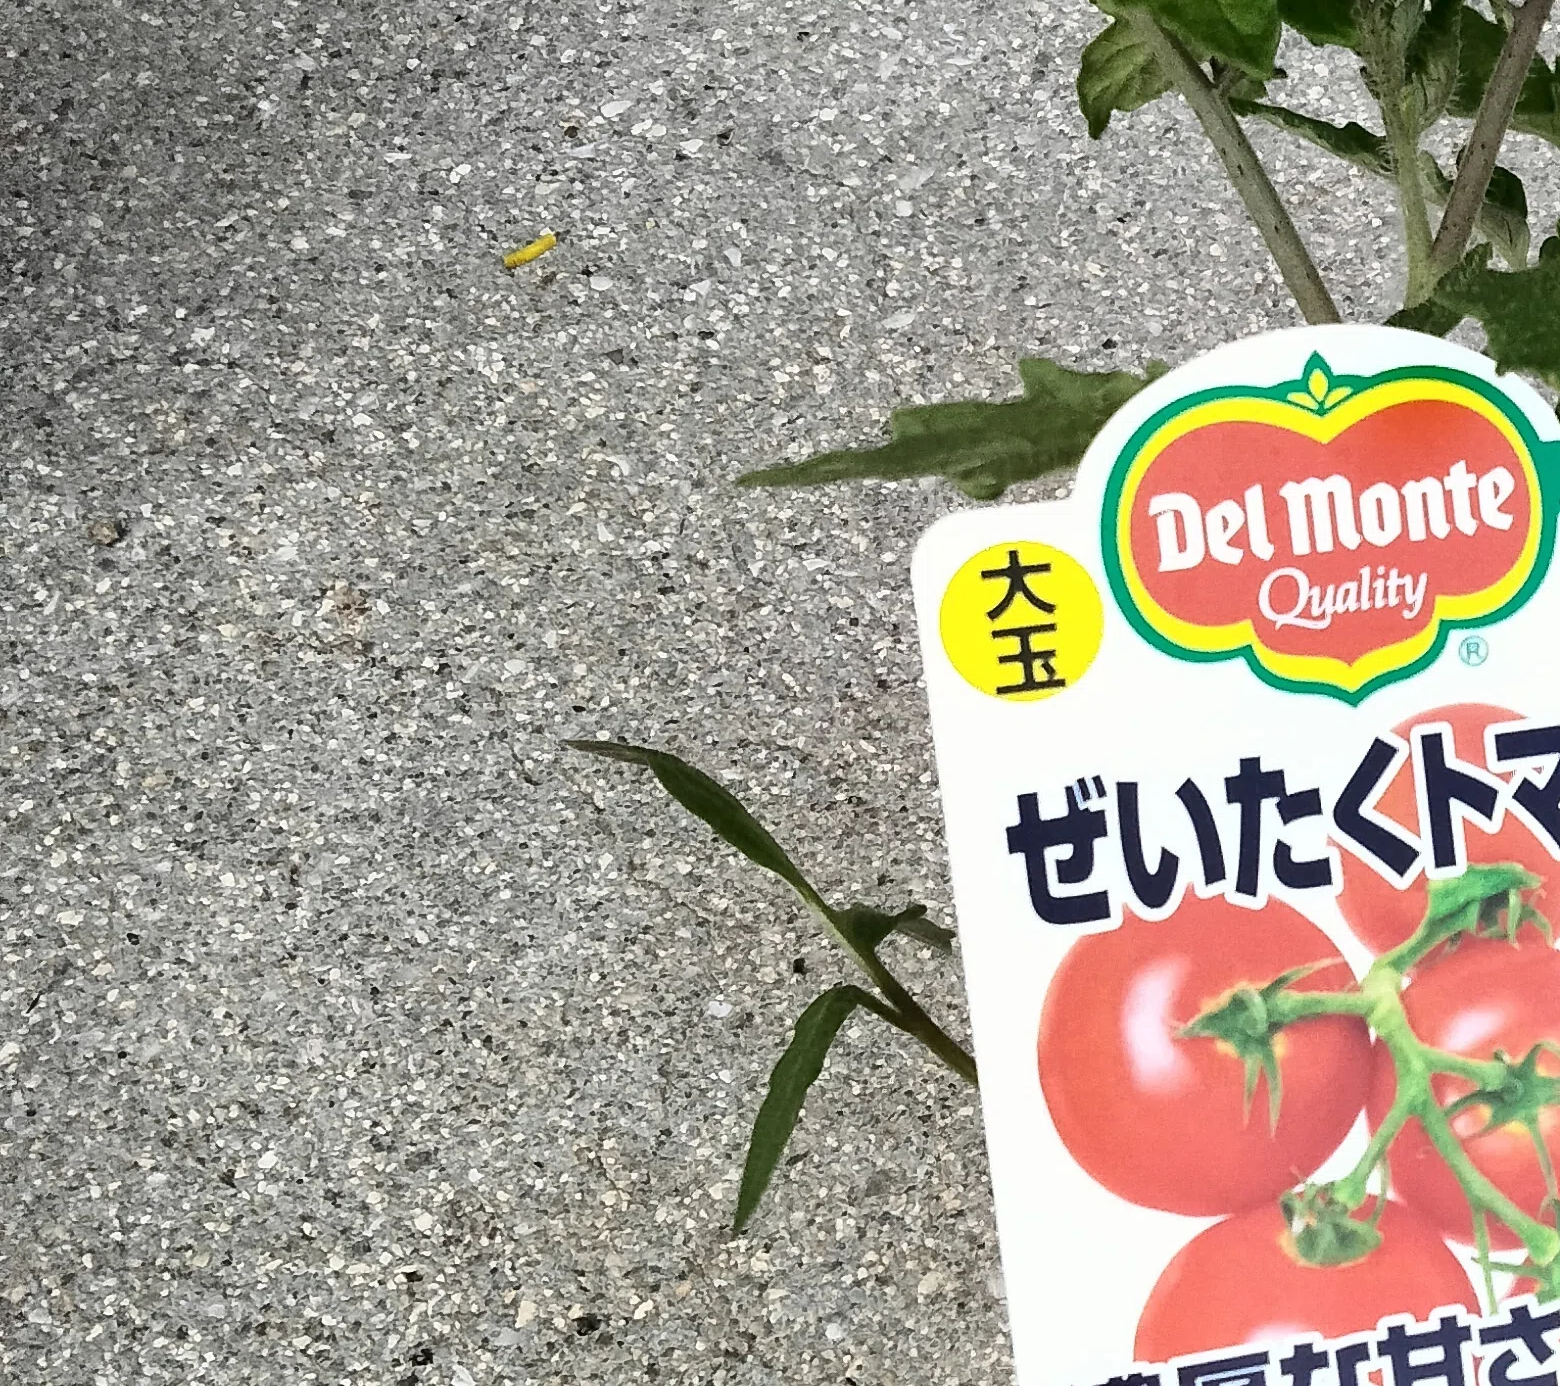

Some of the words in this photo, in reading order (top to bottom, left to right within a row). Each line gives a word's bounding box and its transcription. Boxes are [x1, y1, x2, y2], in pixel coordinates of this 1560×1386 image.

[1148, 482, 1276, 573] Del
[1279, 459, 1516, 557] Monte
[980, 549, 1067, 696] 大玉
[1257, 565, 1430, 631] Quality
